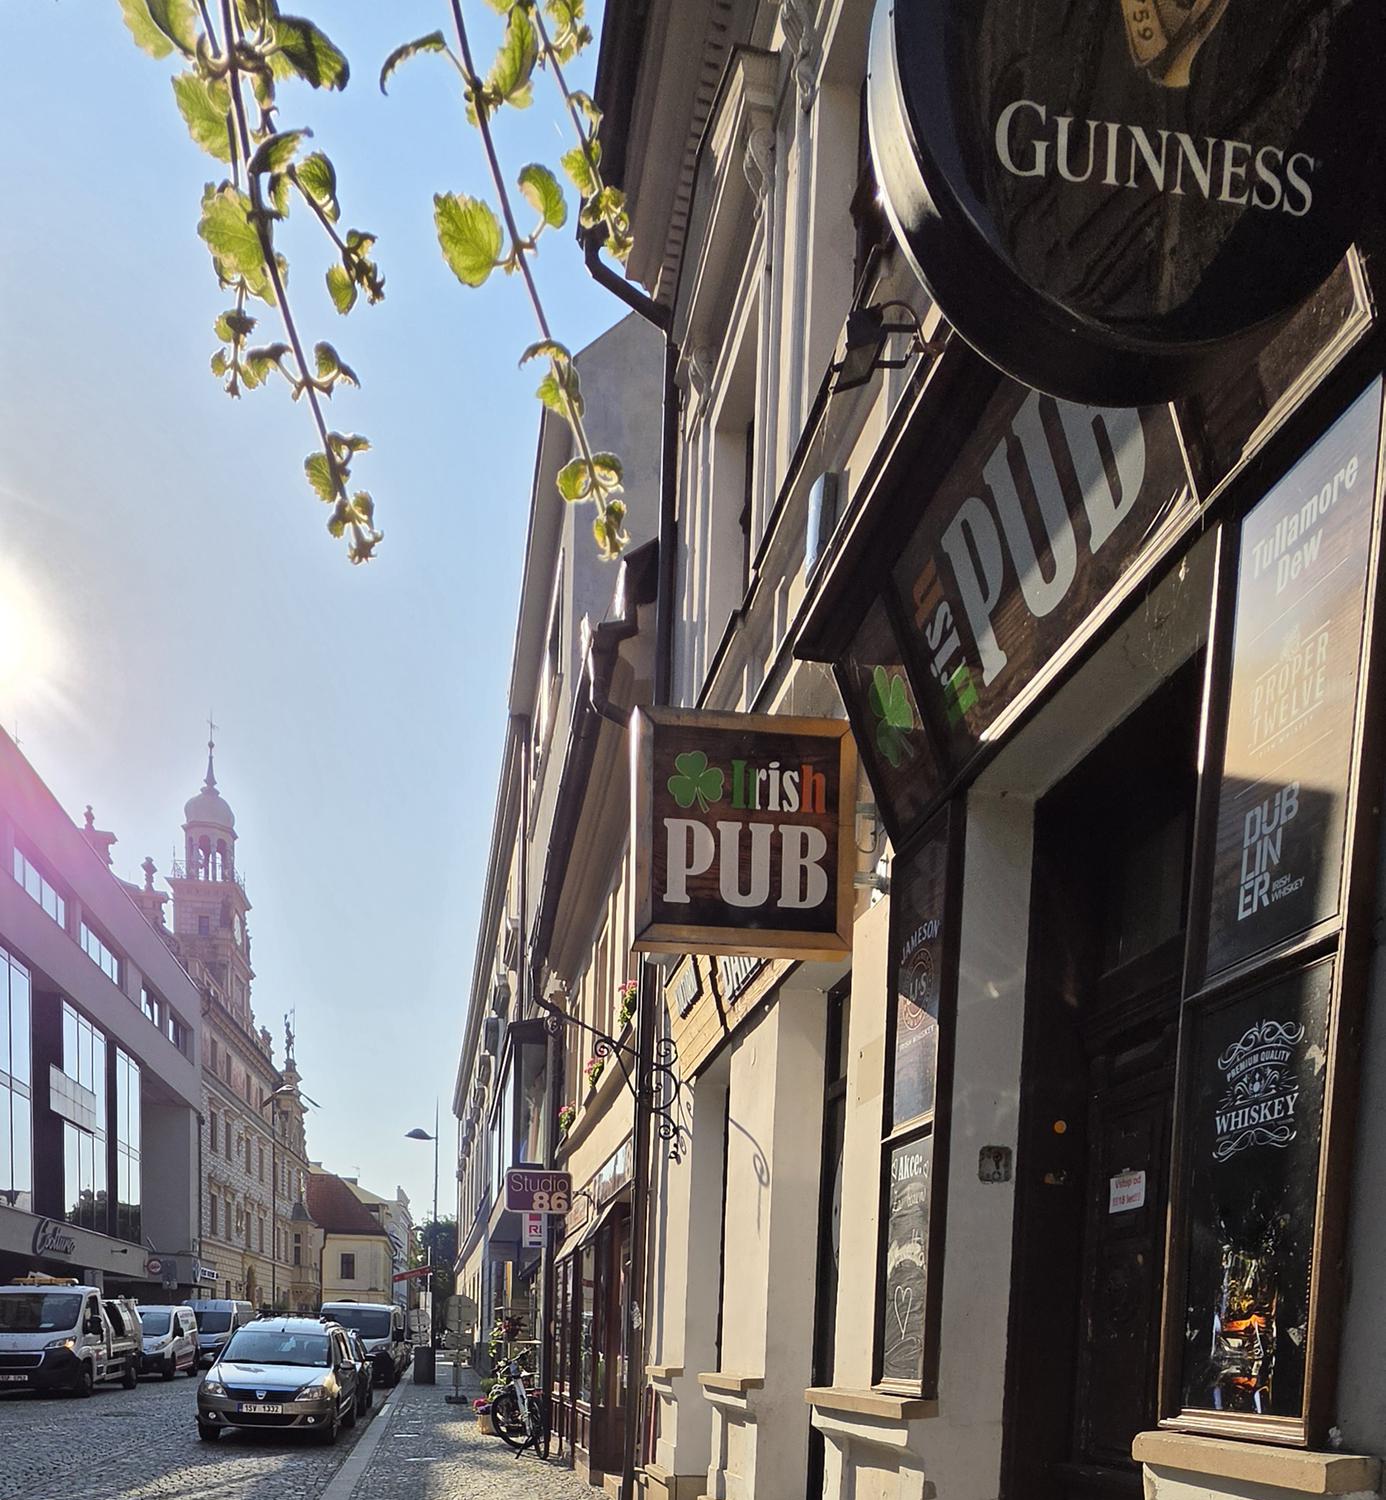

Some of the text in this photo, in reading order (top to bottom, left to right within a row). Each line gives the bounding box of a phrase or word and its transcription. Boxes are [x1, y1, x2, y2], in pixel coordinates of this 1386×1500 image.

[994, 99, 1316, 217] GUINNESS
[1252, 455, 1359, 579] Tullamore
[1276, 528, 1323, 595] Dew
[1252, 631, 1329, 716] PROPER
[1248, 665, 1326, 748] TWELVE
[731, 761, 827, 813] Irish
[1243, 781, 1300, 848] DUB
[663, 818, 829, 909] PUB
[1241, 827, 1283, 885] LIN
[1238, 872, 1271, 921] ER
[1271, 877, 1305, 903] WHISKEY
[1272, 873, 1292, 892] IRISH
[900, 919, 941, 965] JAMESON
[1226, 1049, 1292, 1083] PREMIUM QUALITY
[1215, 1093, 1299, 1135] WHISKEY
[511, 1173, 569, 1193] Studio
[532, 1191, 569, 1211] 86
